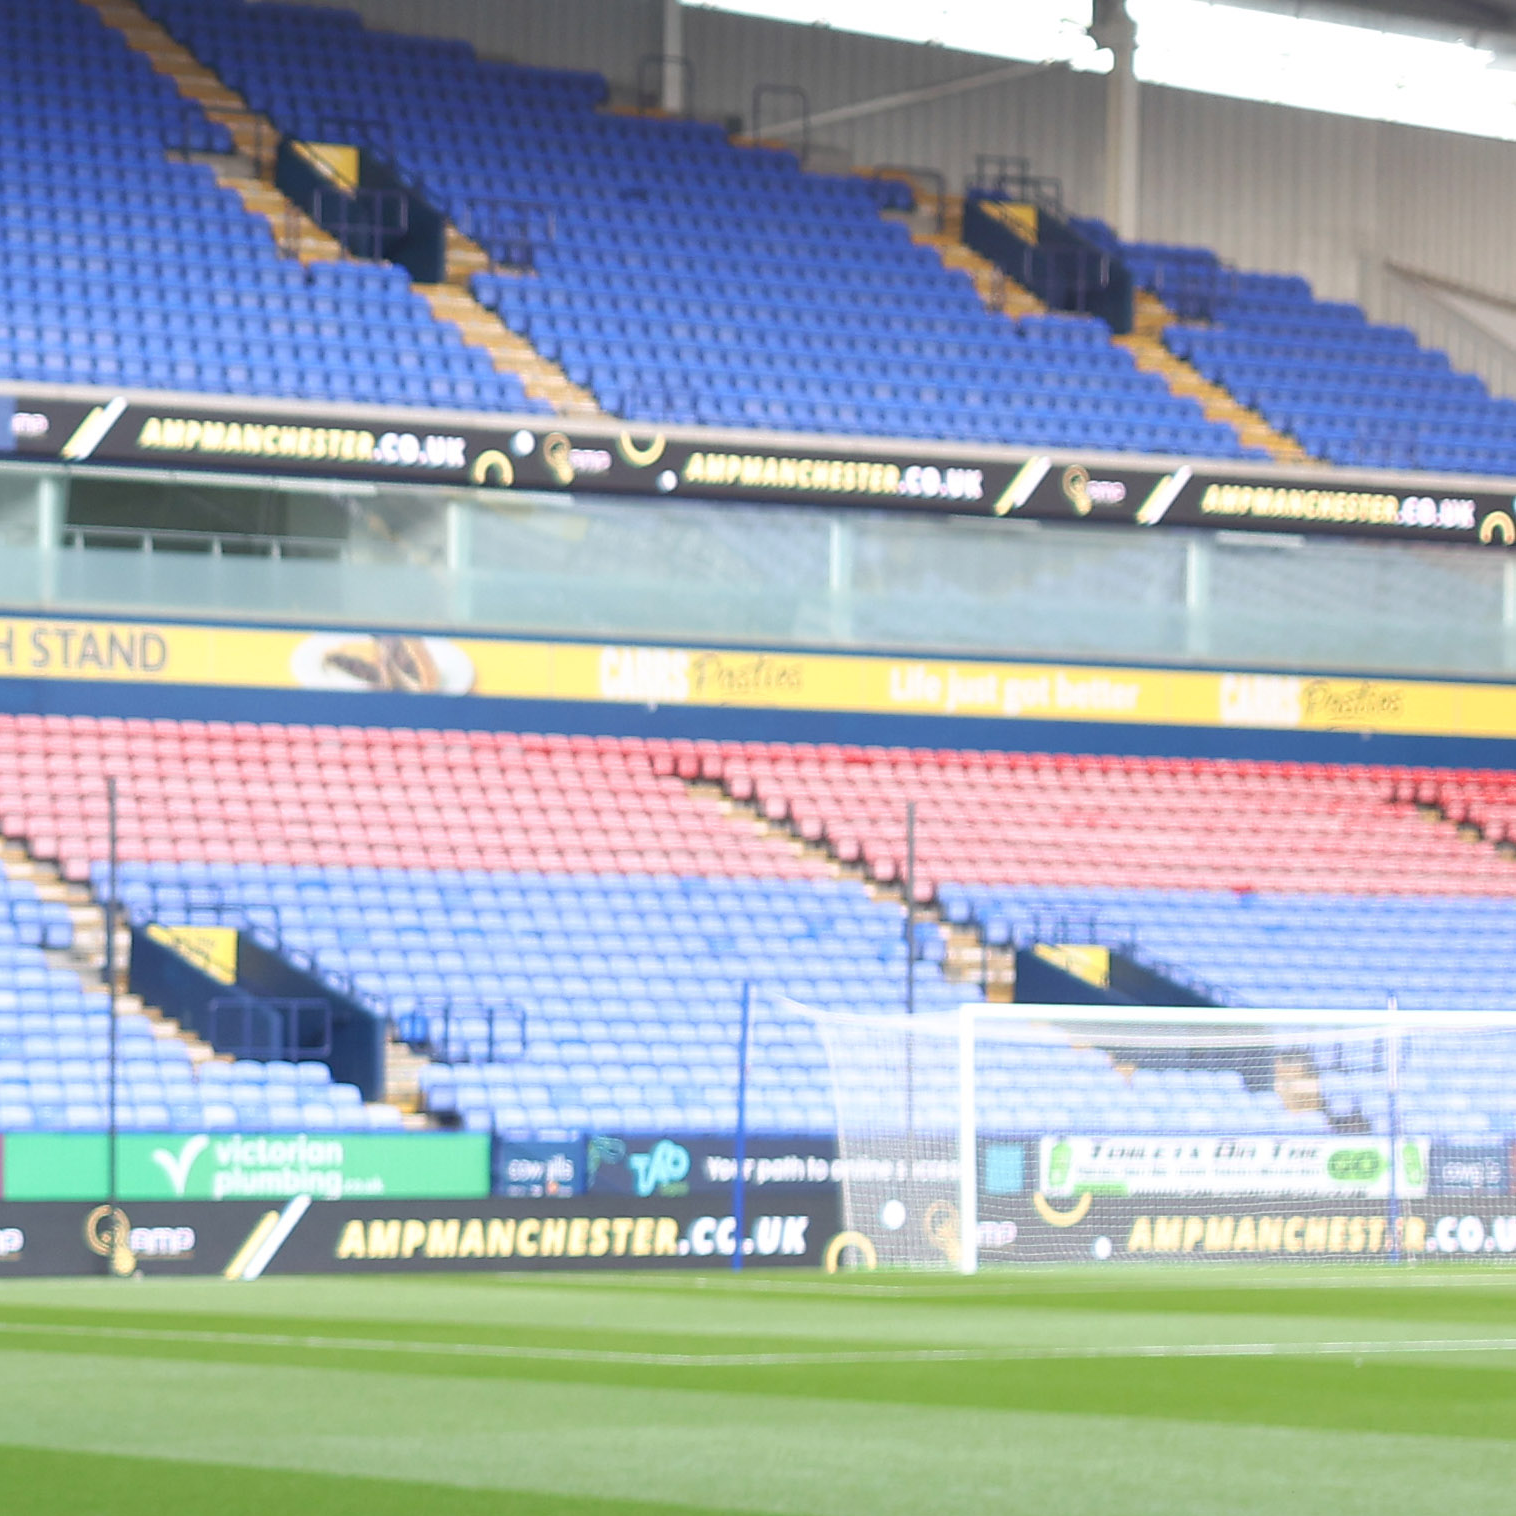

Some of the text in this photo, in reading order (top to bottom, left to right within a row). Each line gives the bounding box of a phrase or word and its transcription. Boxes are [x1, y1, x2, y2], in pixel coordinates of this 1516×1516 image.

[135, 415, 468, 469] AMPMANCHESTER.CO.UK
[683, 452, 983, 500] AMPMANCHESTER.CO.UK
[1201, 483, 1477, 530] AMPMANCHESTER.CO.UK
[31, 627, 169, 673] STAND
[889, 666, 1141, 715] Life just got better
[214, 1134, 343, 1167] victorian
[707, 1154, 754, 1182] Yor
[336, 1215, 809, 1259] AMPMANCHESTER.CO.UK
